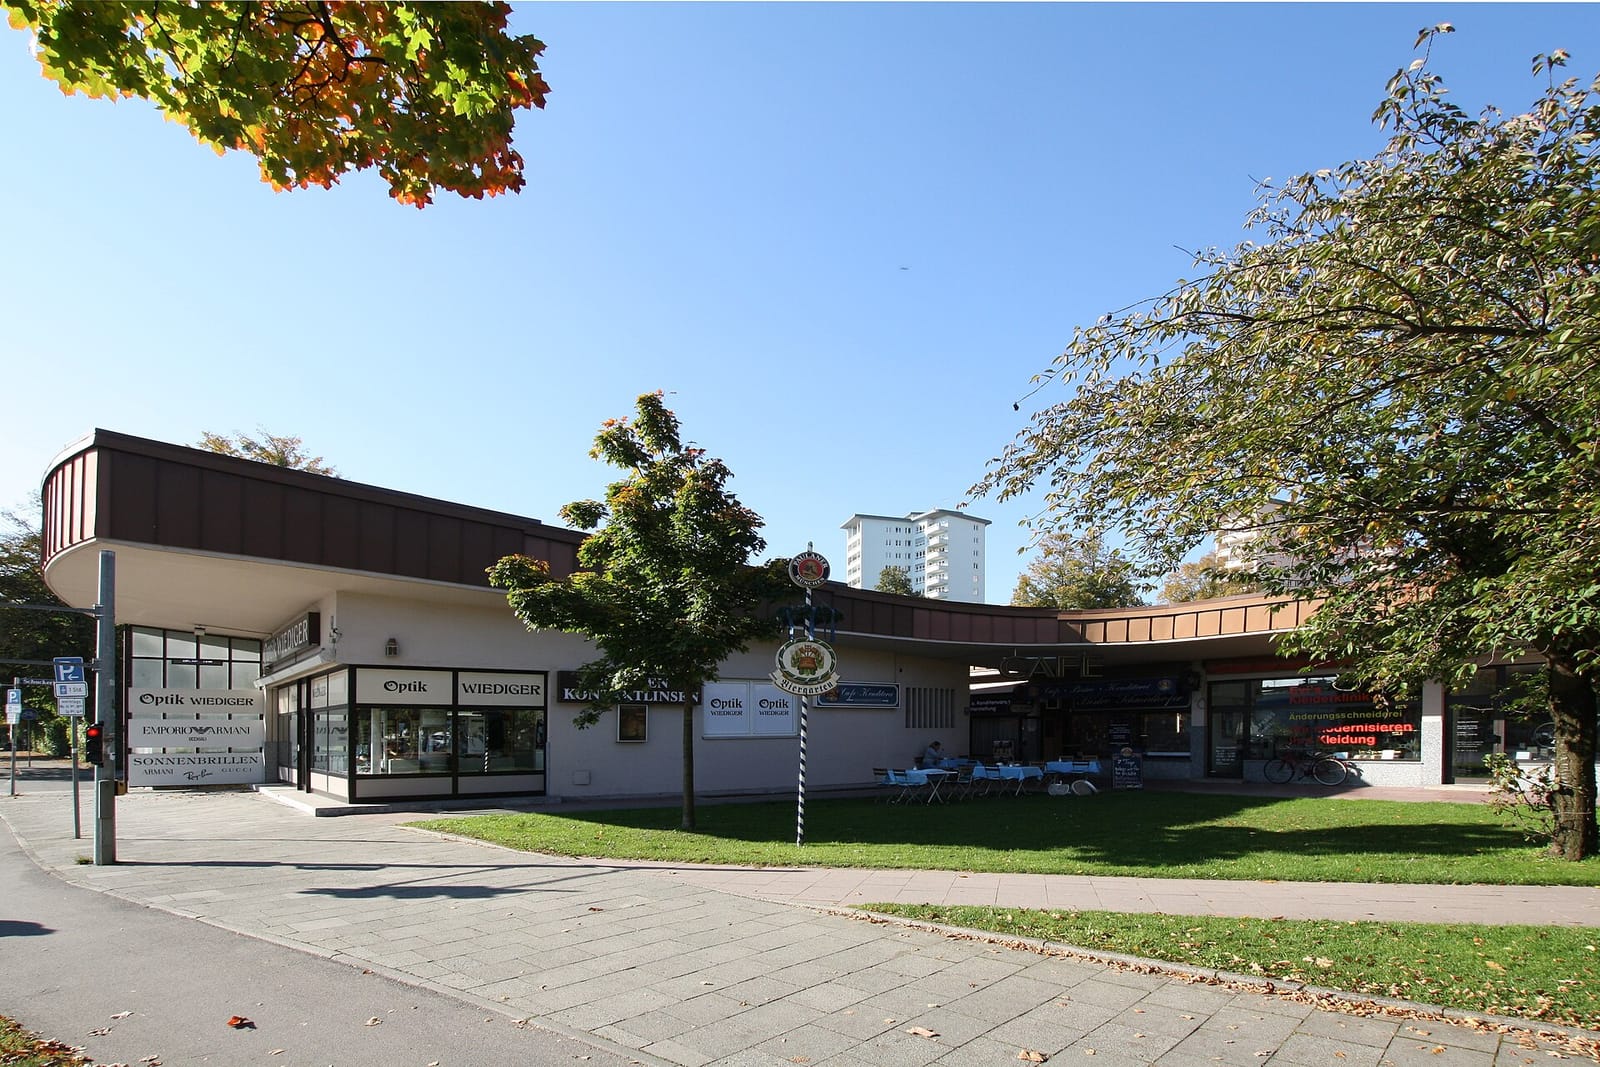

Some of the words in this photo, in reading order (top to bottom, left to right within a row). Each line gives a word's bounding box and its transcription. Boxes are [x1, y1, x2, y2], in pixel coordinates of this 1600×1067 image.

[793, 552, 829, 569] PAULANER
[276, 619, 309, 655] WIEDIGER
[23, 678, 54, 686] Schucker
[780, 679, 834, 696] Biergarten
[384, 680, 428, 694] Optik
[462, 682, 542, 696] WIEDIGER
[139, 693, 185, 706] Optik
[190, 697, 255, 706] WIEDIGER
[563, 688, 699, 702] KONTLINSEN
[711, 698, 743, 710] Optik
[759, 698, 789, 709] Optik
[1289, 711, 1402, 721] Änderungsschneiderei
[143, 726, 193, 735] EMPORIO
[209, 726, 250, 735] ARMANI
[1318, 735, 1377, 746] Kleidung
[133, 756, 259, 766] SONNENBRILLEN
[143, 768, 174, 776] ARMANI
